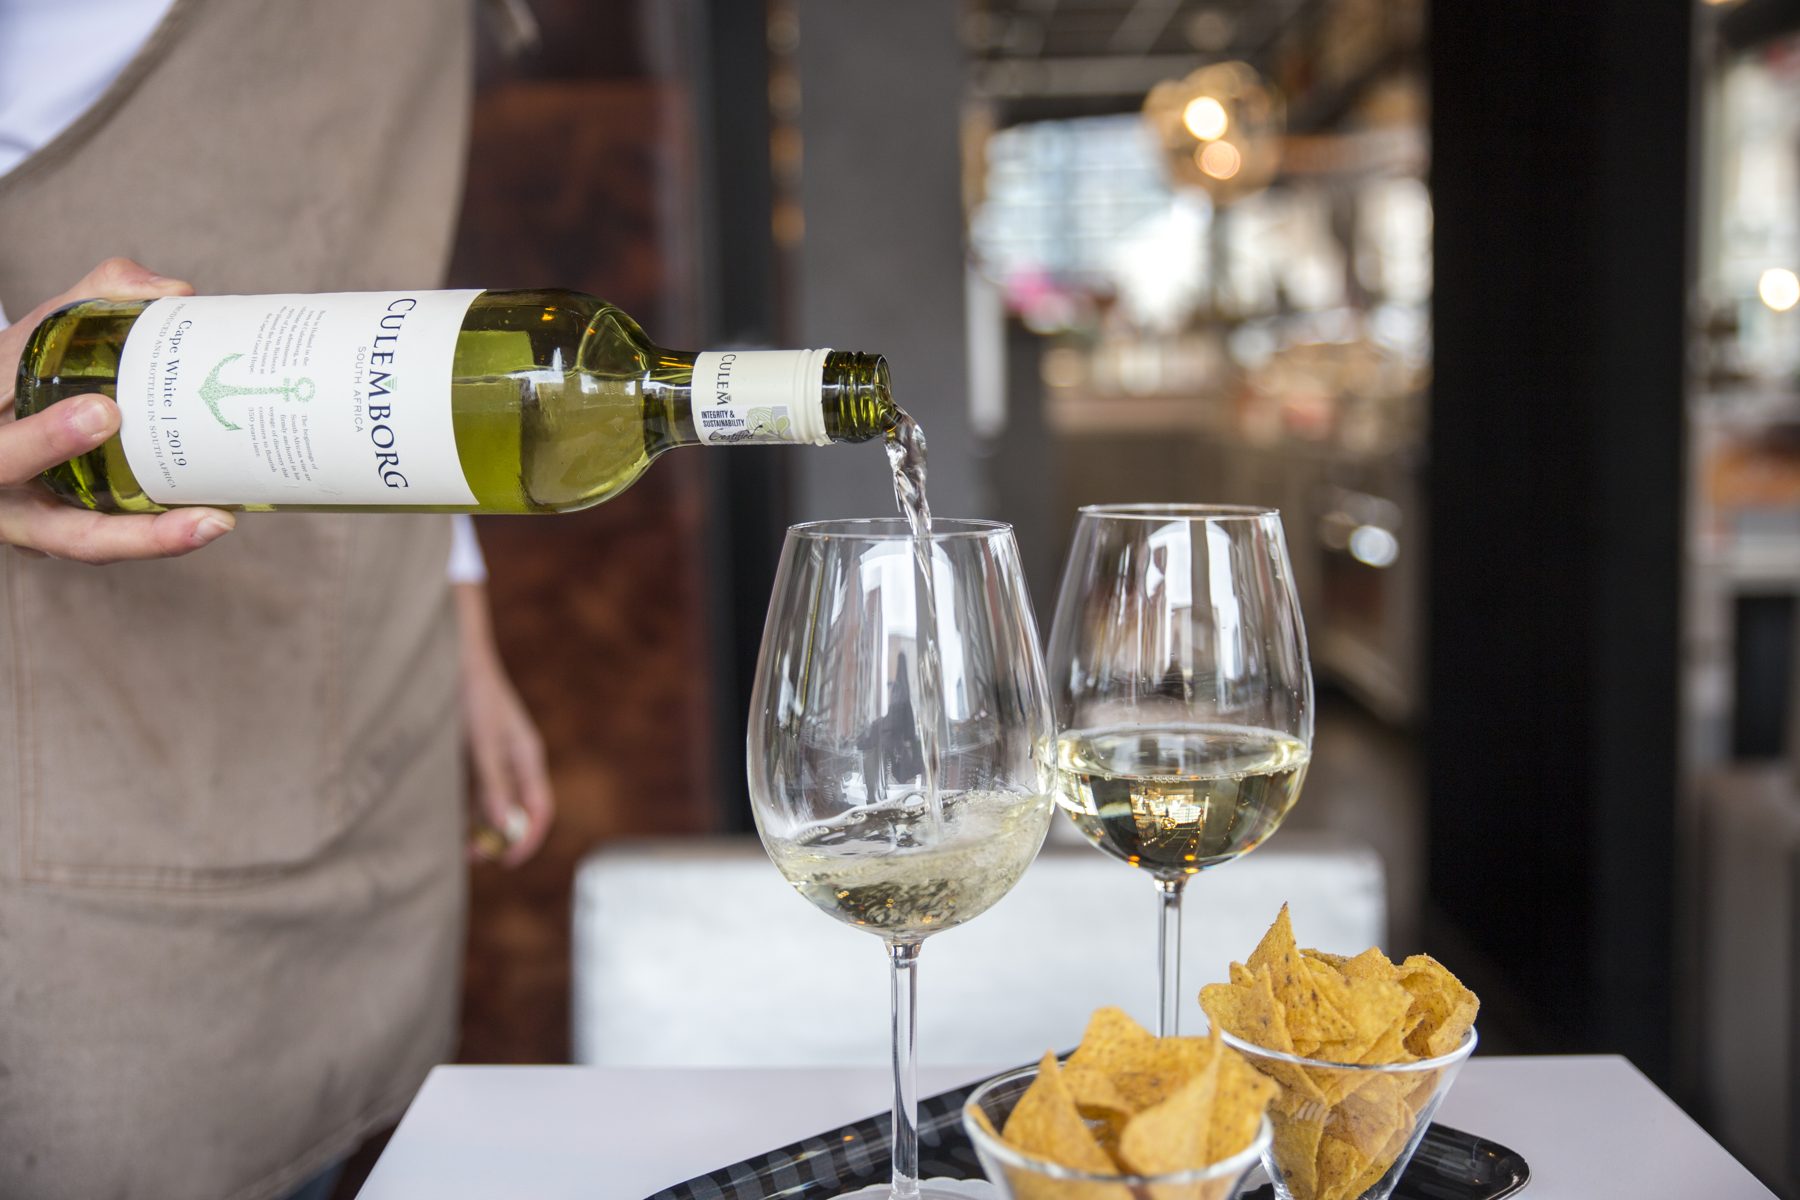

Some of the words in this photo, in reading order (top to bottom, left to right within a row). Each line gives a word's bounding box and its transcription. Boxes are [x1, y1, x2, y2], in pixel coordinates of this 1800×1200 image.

[159, 303, 186, 337] PRODUCED
[152, 340, 162, 358] AND
[169, 320, 192, 353] Cape
[252, 340, 261, 355] Good
[249, 357, 257, 375] Hope.
[271, 348, 280, 374] Riebeeck
[355, 346, 366, 384] SOUTH
[147, 362, 157, 406] BOTTLED
[163, 360, 179, 407] White
[368, 299, 416, 489] CULEMBORG
[148, 411, 154, 421] IN
[268, 406, 276, 428] voyage
[290, 414, 298, 433] South
[353, 390, 363, 432] AFRICA
[701, 411, 728, 419] INTEGRITY
[149, 426, 162, 458] SOUTH
[248, 424, 256, 440] years
[272, 430, 278, 438] of
[709, 425, 763, 442] Certified
[166, 430, 187, 466] 2019
[273, 439, 284, 466] discovery
[283, 436, 294, 464] anchored
[293, 435, 302, 458] African
[303, 429, 314, 462] beginnings
[265, 449, 277, 473] flourish
[281, 467, 290, 478] that
[159, 461, 176, 489] AFRICA
